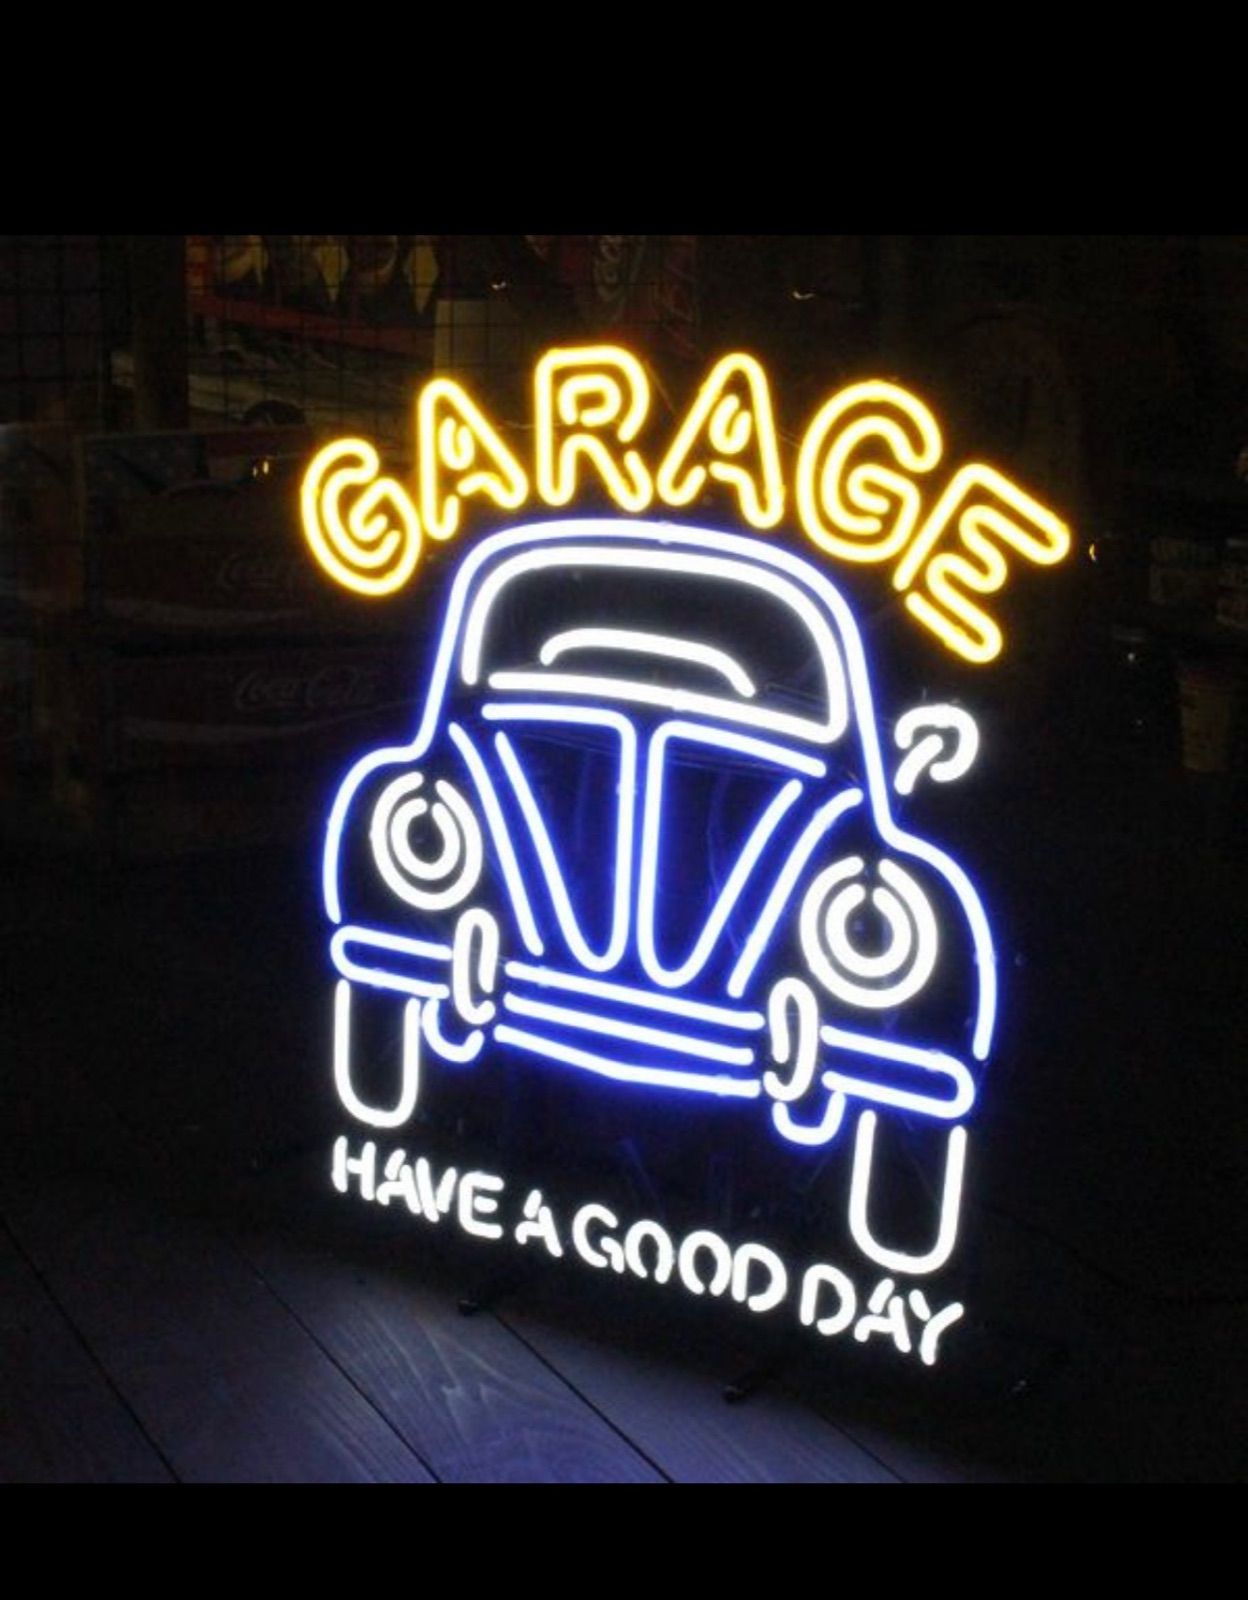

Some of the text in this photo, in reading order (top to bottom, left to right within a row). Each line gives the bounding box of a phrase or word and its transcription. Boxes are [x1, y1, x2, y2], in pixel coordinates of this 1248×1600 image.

[299, 343, 1072, 665] GARAGE
[331, 1135, 964, 1366] HAVE A GOOD DAY
